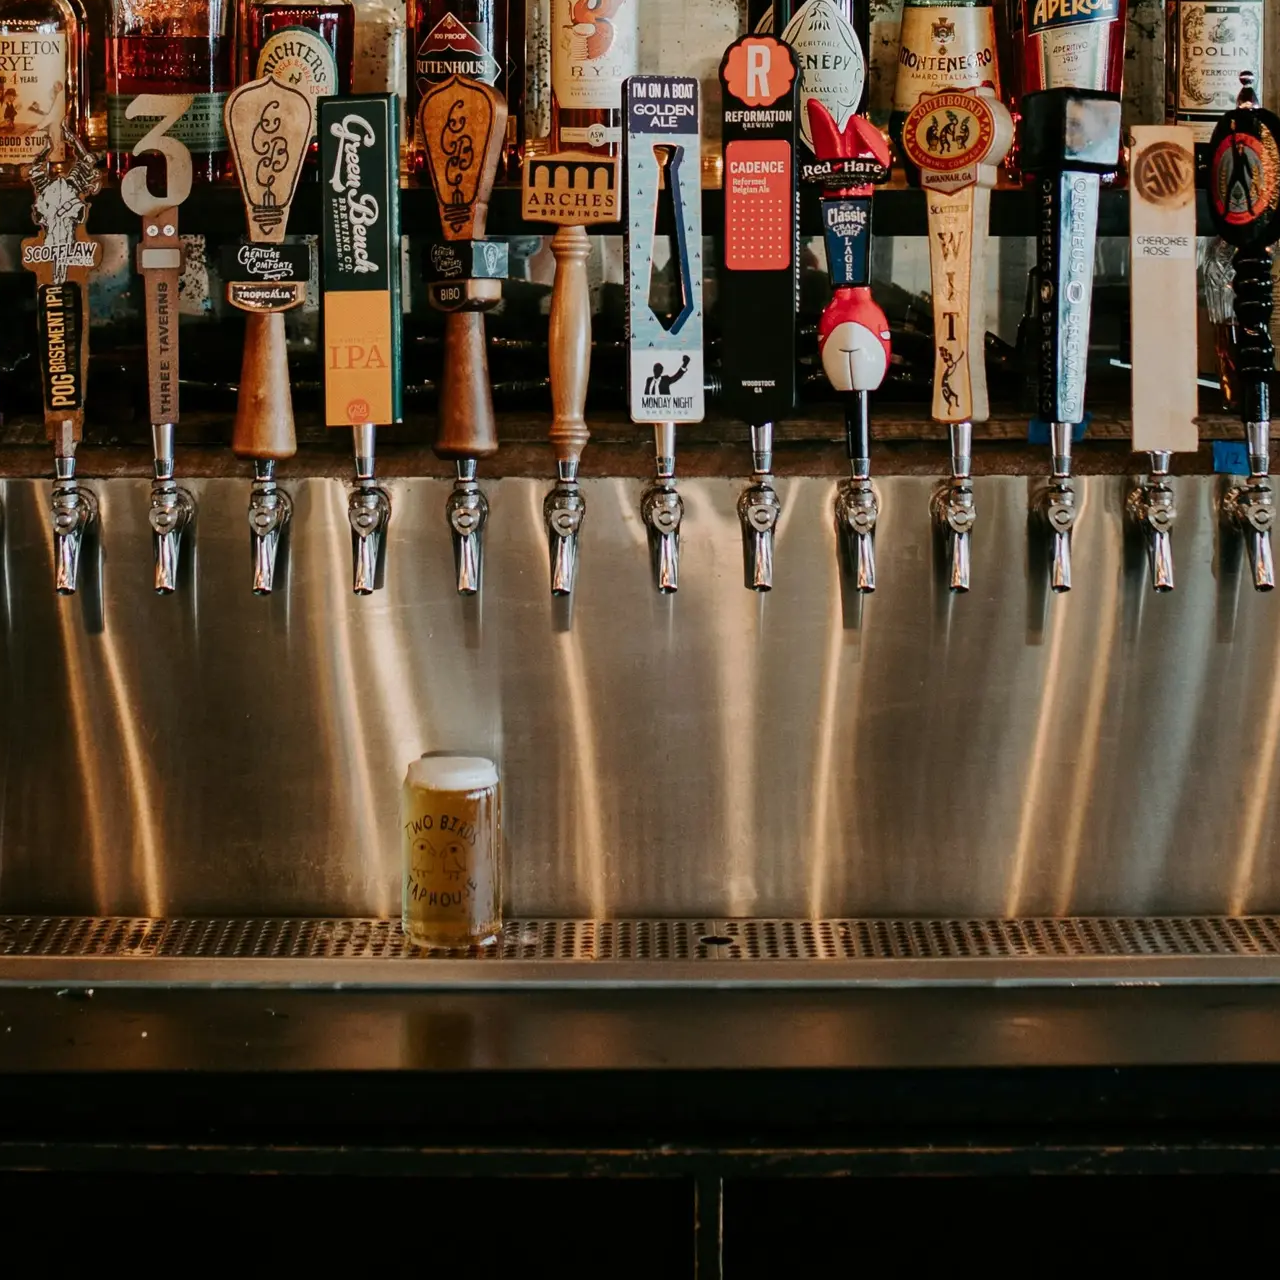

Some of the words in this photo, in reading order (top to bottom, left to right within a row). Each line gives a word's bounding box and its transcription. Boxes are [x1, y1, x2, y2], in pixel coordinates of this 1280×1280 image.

[1052, 41, 1089, 54] APERITIVO
[1192, 46, 1250, 57] DOLIN
[799, 51, 852, 71] ÉNÉPY
[899, 46, 993, 72] MONTENEGRO
[570, 65, 623, 78] RYE
[745, 44, 772, 98] R
[910, 72, 939, 81] AMARO
[19, 76, 39, 84] YEARS
[632, 82, 647, 99] I'M
[648, 82, 662, 99] ON
[663, 83, 671, 99] A
[671, 83, 694, 99] BOAT
[632, 103, 695, 117] GOLDEN
[911, 93, 984, 121] SOUTHBOUND
[649, 116, 679, 128] ALE
[724, 110, 793, 123] REFORMATION
[741, 121, 776, 131] BREWERY
[590, 130, 605, 140] ASW
[120, 93, 196, 216] 3
[328, 113, 376, 194] Green
[729, 161, 785, 174] CADENCE
[801, 161, 833, 179] Red
[843, 159, 883, 175] Hare
[732, 177, 767, 187] Reformed
[924, 173, 962, 184] SAVANNAH,
[961, 172, 972, 181] GA
[732, 185, 759, 195] Belgian
[527, 191, 615, 208] ARCHES
[540, 209, 600, 218] BREWING
[827, 206, 868, 227] Classic
[338, 197, 352, 253] BREWING
[346, 188, 380, 275] Bench
[832, 222, 865, 234] CRAFT
[836, 228, 861, 238] LIGHT
[1070, 177, 1088, 275] ORPHEUS
[1136, 235, 1189, 247] CHEROKEE
[23, 241, 99, 264] SCOFFLAW
[237, 245, 281, 265] CREATURE
[843, 236, 855, 281] LAGER
[1142, 246, 1172, 257] ROSE
[246, 257, 294, 276] COMFORTS
[45, 285, 64, 308] IPA
[440, 287, 460, 301] BIBO
[158, 281, 171, 357] TAVERNS
[46, 310, 68, 373] BASEMENT
[329, 343, 389, 370] IPA
[50, 373, 77, 407] POG
[159, 361, 172, 416] THREE
[741, 379, 776, 387] WOODSTOCK
[752, 386, 763, 394] GA
[641, 396, 672, 409] MONDAY
[672, 396, 694, 409] NIGHT
[404, 814, 434, 840] TWO
[439, 813, 480, 848] BIRDS
